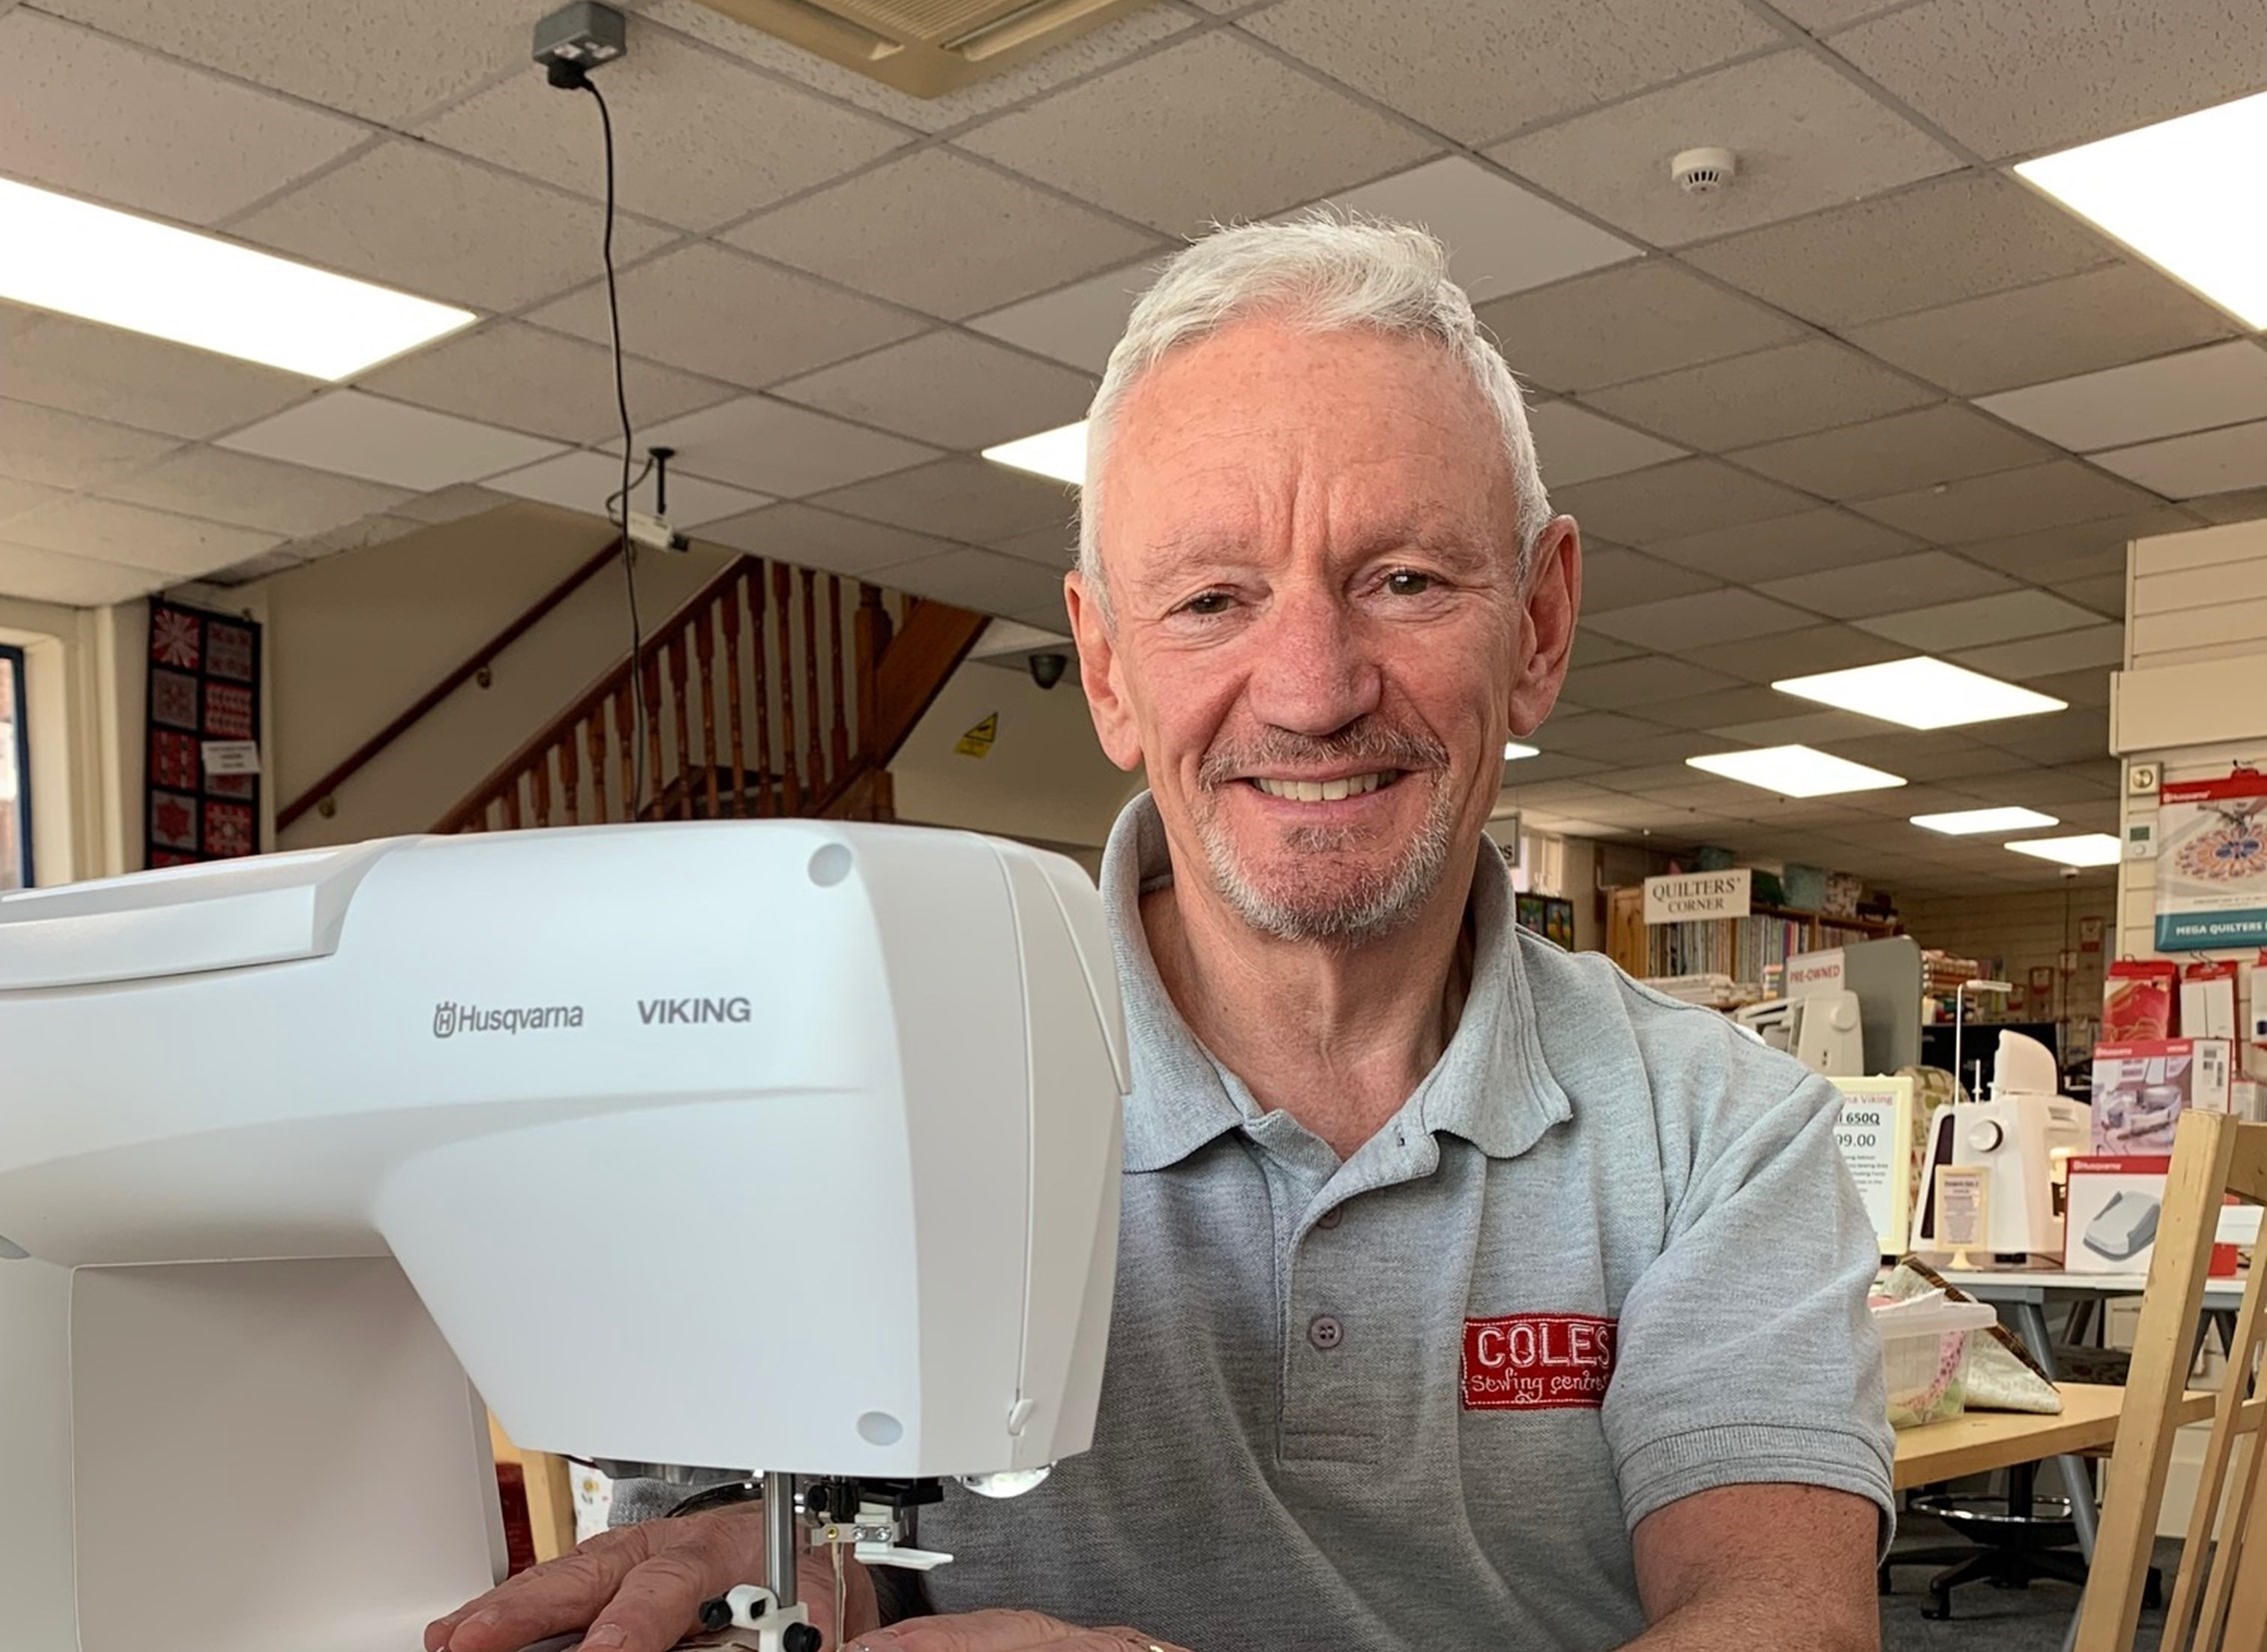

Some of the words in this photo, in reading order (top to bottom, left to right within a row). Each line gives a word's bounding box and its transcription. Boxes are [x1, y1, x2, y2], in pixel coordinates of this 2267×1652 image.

[1652, 876, 1741, 902] QUILTERS'
[1668, 897, 1724, 913] CORNER
[2175, 924, 2207, 935] MEGA
[2209, 921, 2262, 934] QUILTERS
[1789, 964, 1841, 983] PRE-OWNED
[458, 1004, 584, 1035] Husqvarna
[637, 996, 752, 1025] VIKING
[1860, 1095, 1893, 1106] Viking
[1845, 1111, 1880, 1126] 650Q
[1477, 1323, 1611, 1368] COLES
[1470, 1367, 1543, 1403] Sewing
